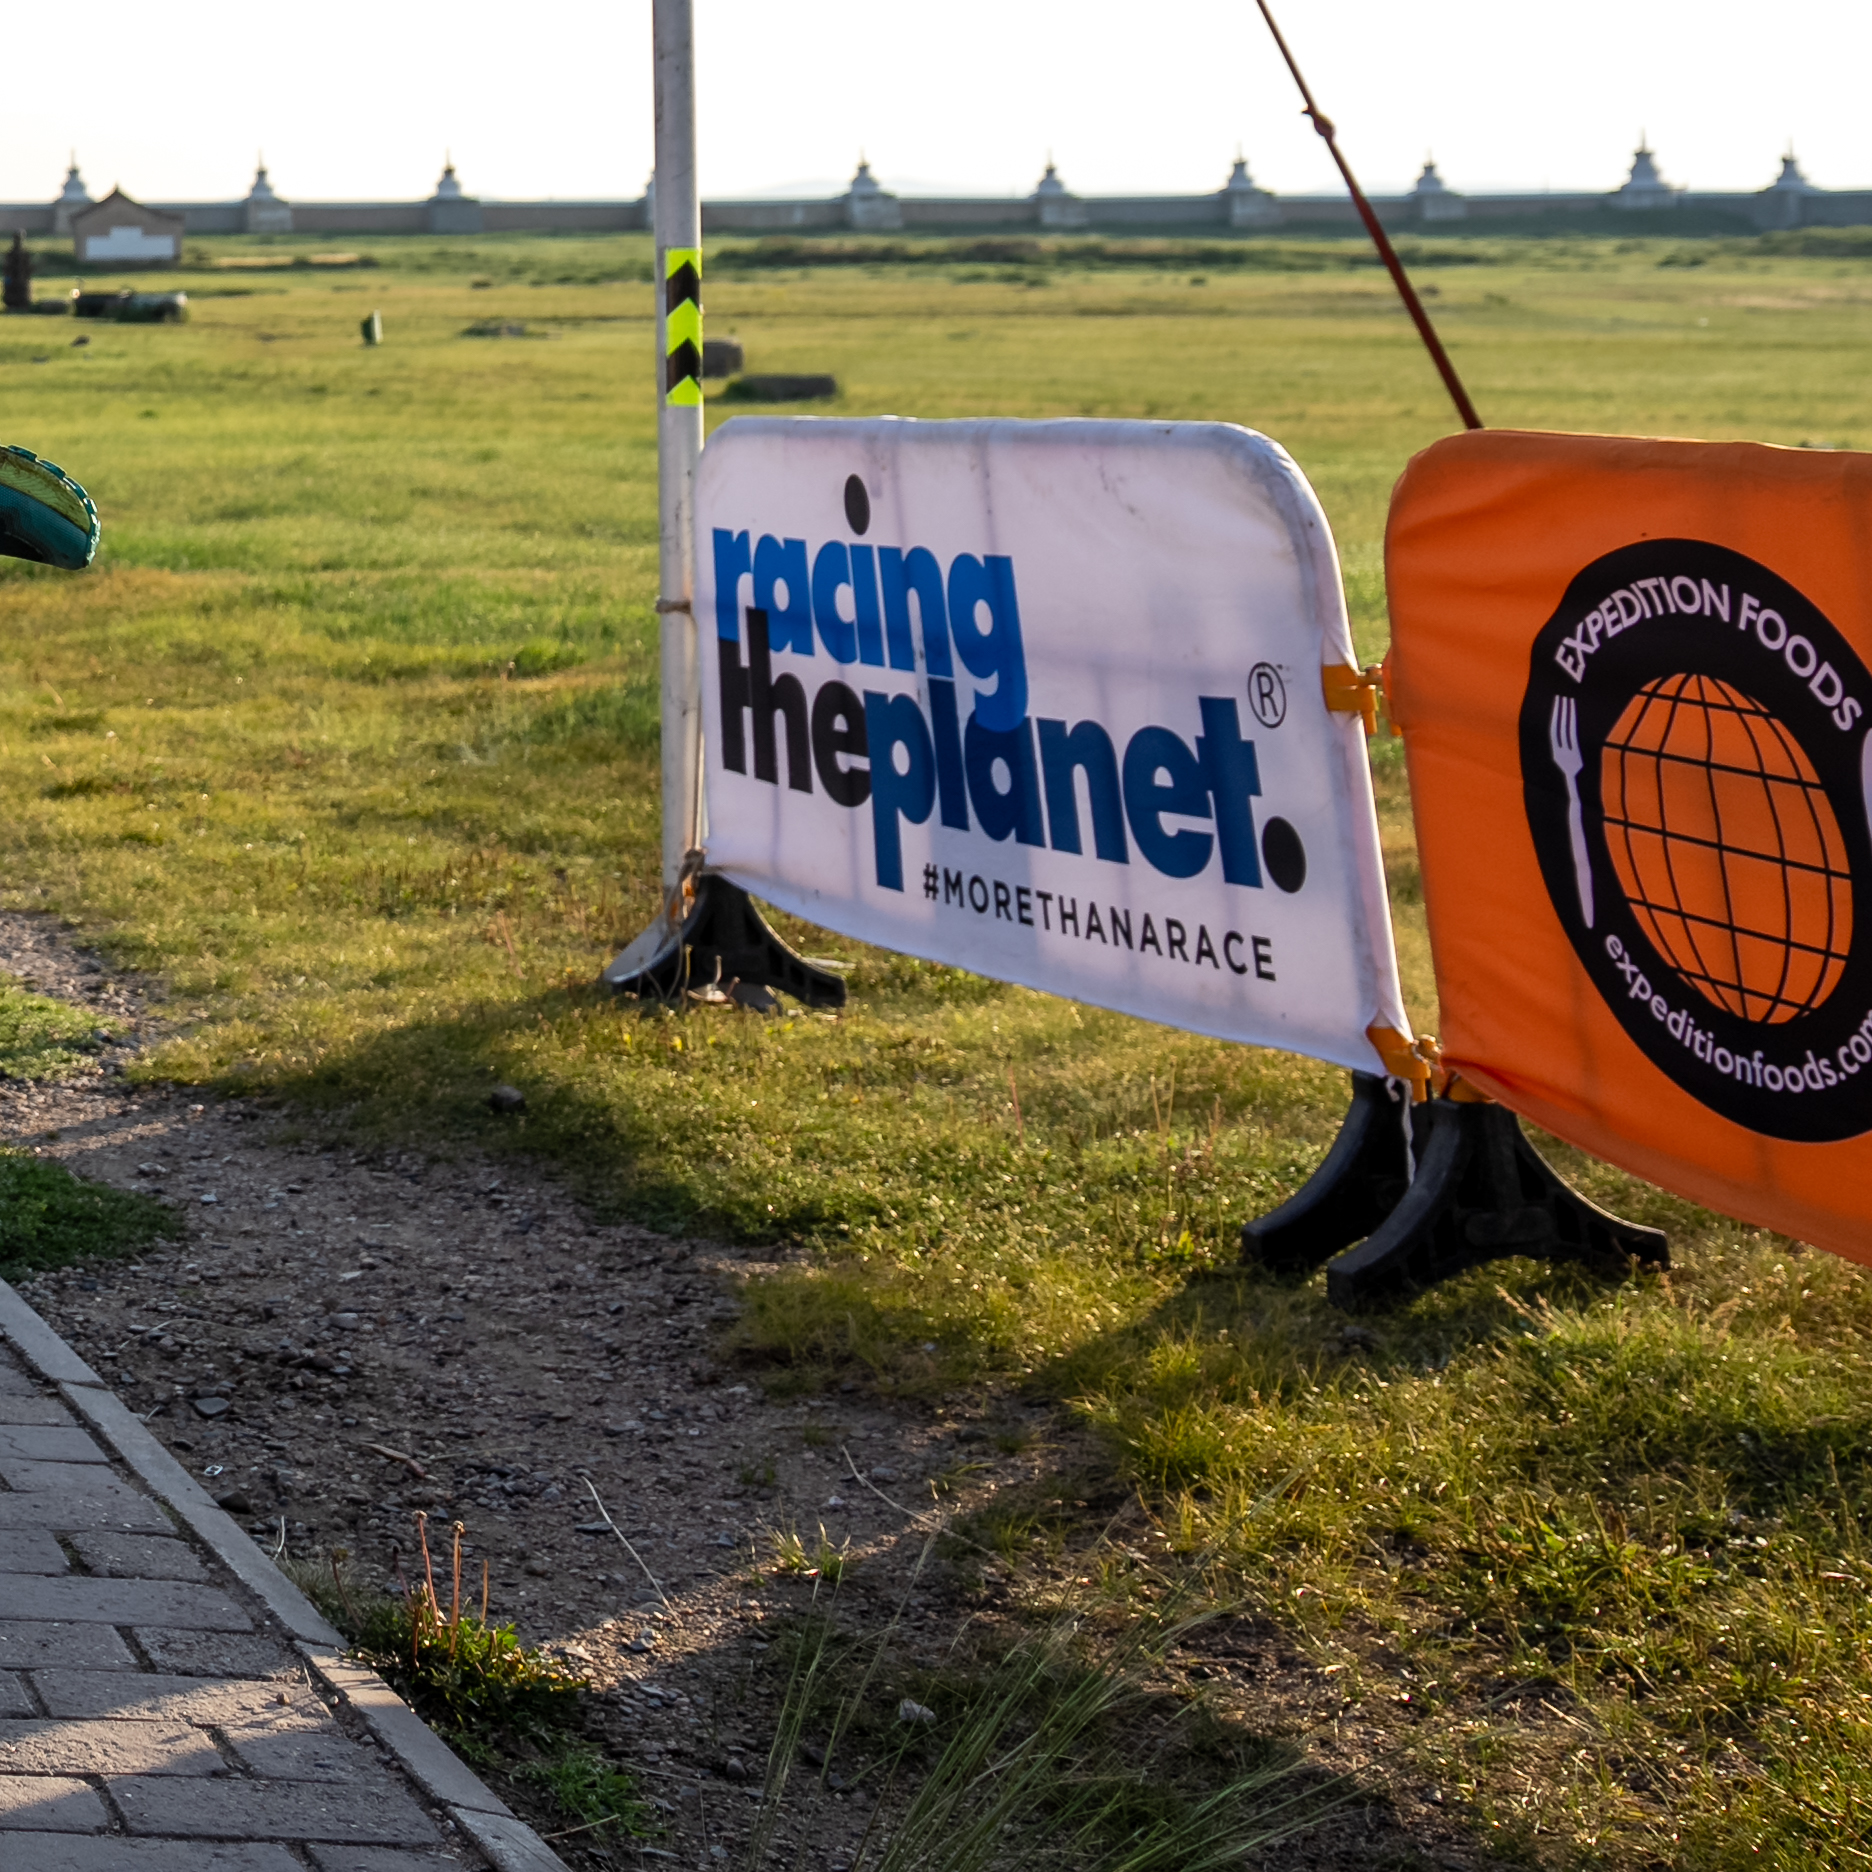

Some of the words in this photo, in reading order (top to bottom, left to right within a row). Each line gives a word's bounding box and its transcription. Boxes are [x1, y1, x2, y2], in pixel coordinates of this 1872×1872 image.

[712, 474, 1029, 732] racing
[1555, 575, 1731, 684] EXPEDITION
[1739, 595, 1863, 732] FOODS
[922, 862, 1277, 982] #MORETHANARACE
